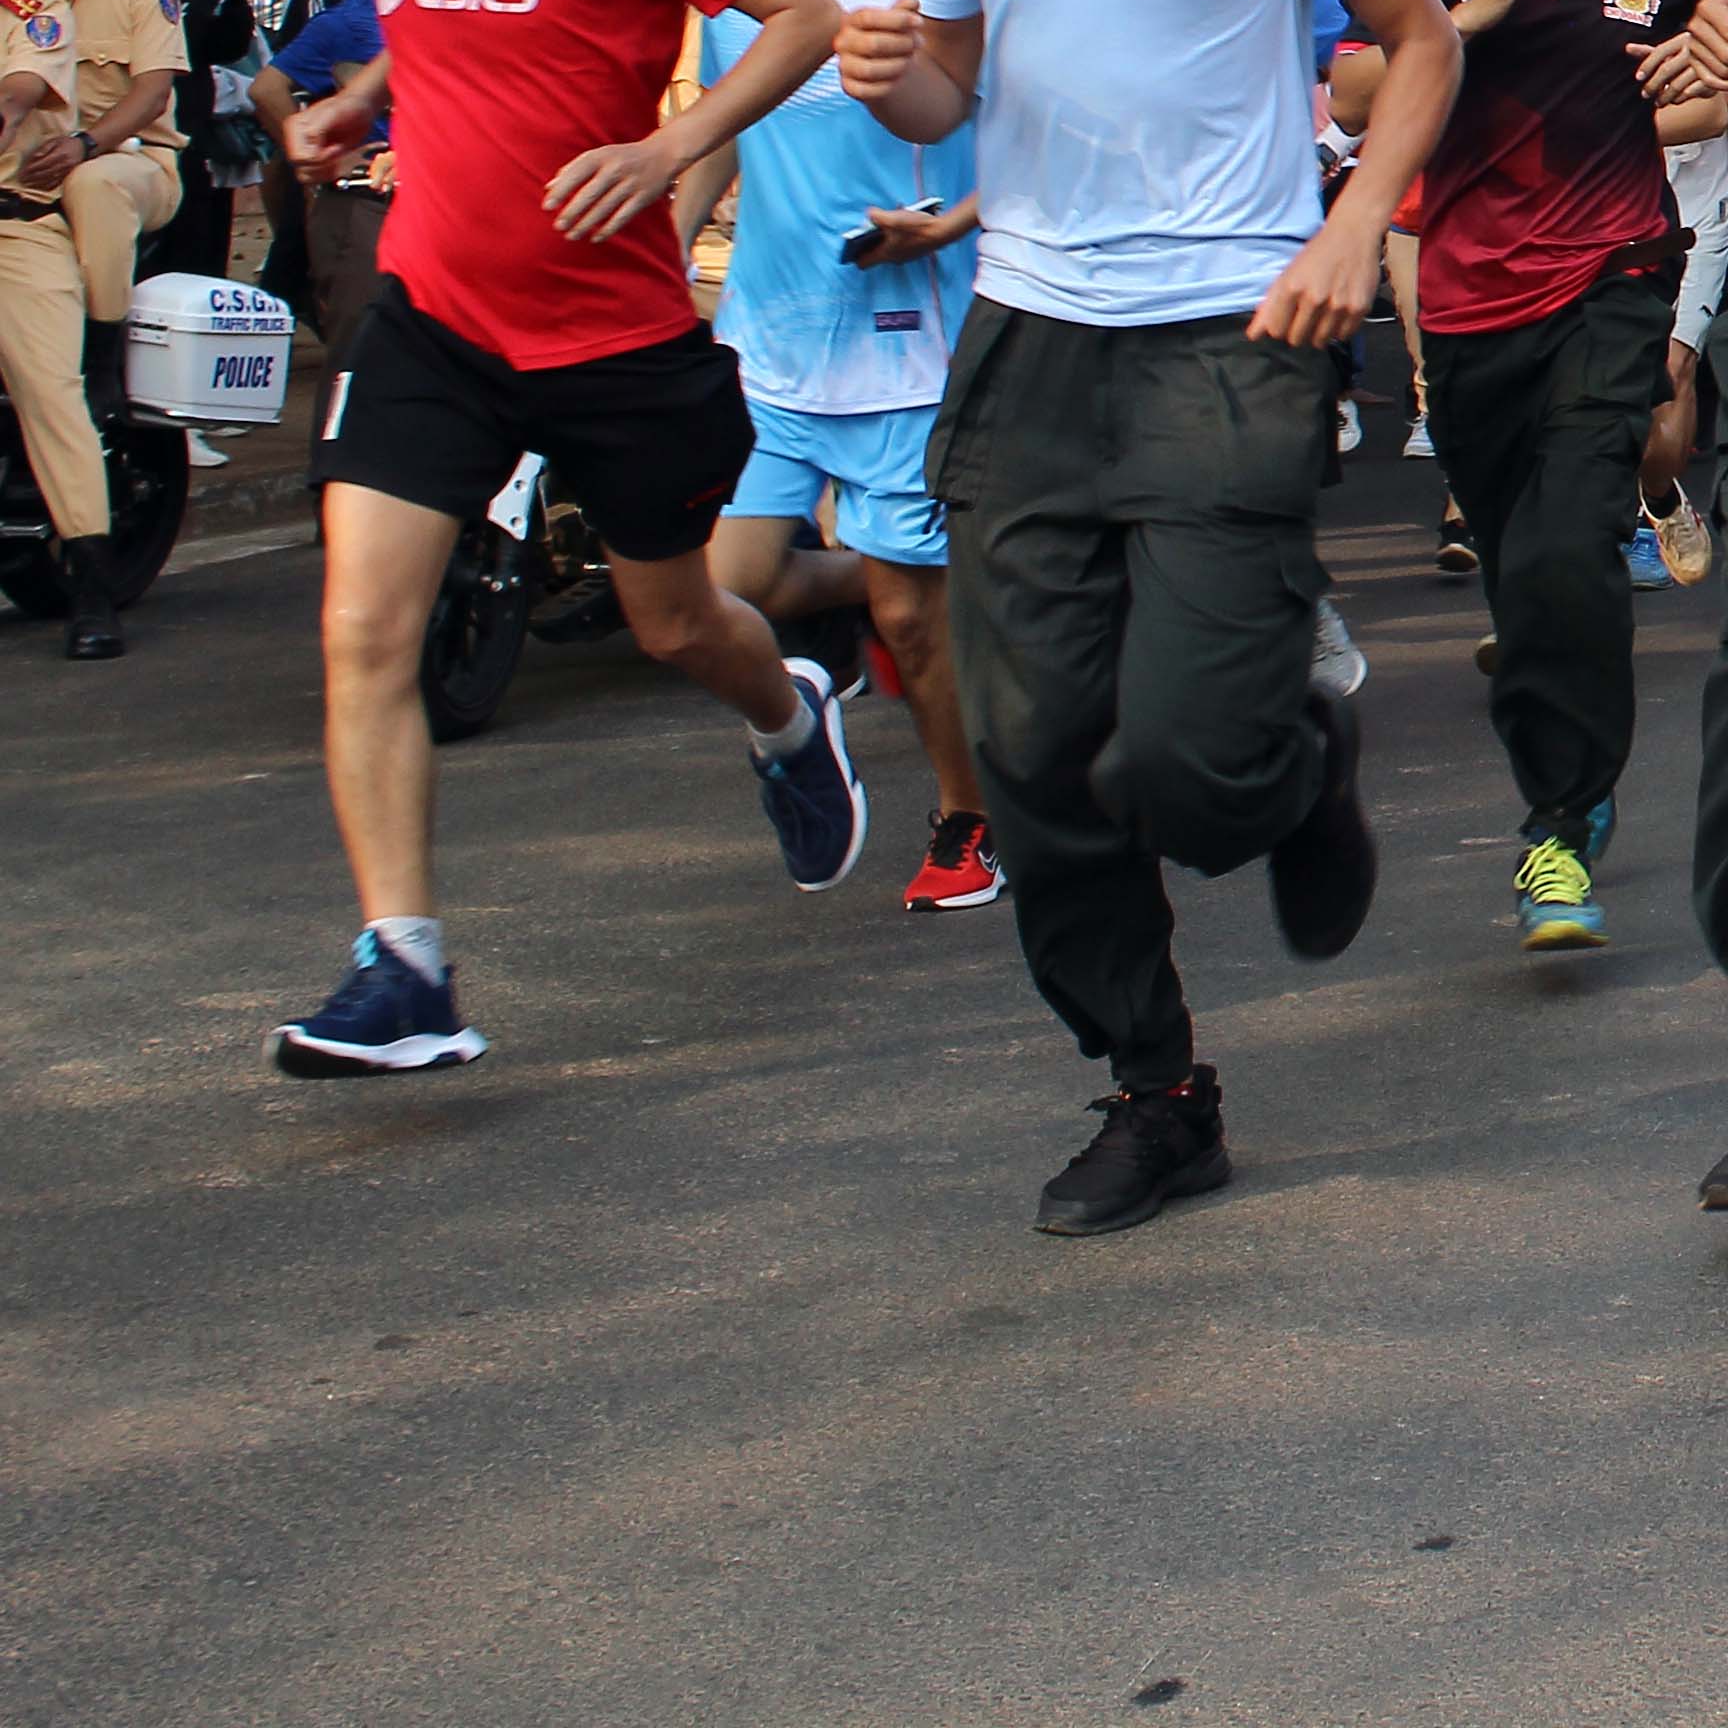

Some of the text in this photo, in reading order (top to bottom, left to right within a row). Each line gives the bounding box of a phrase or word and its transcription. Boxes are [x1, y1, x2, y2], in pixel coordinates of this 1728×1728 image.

[211, 318, 286, 331] TRAFFIC POLICE
[212, 356, 275, 388] POLICE
